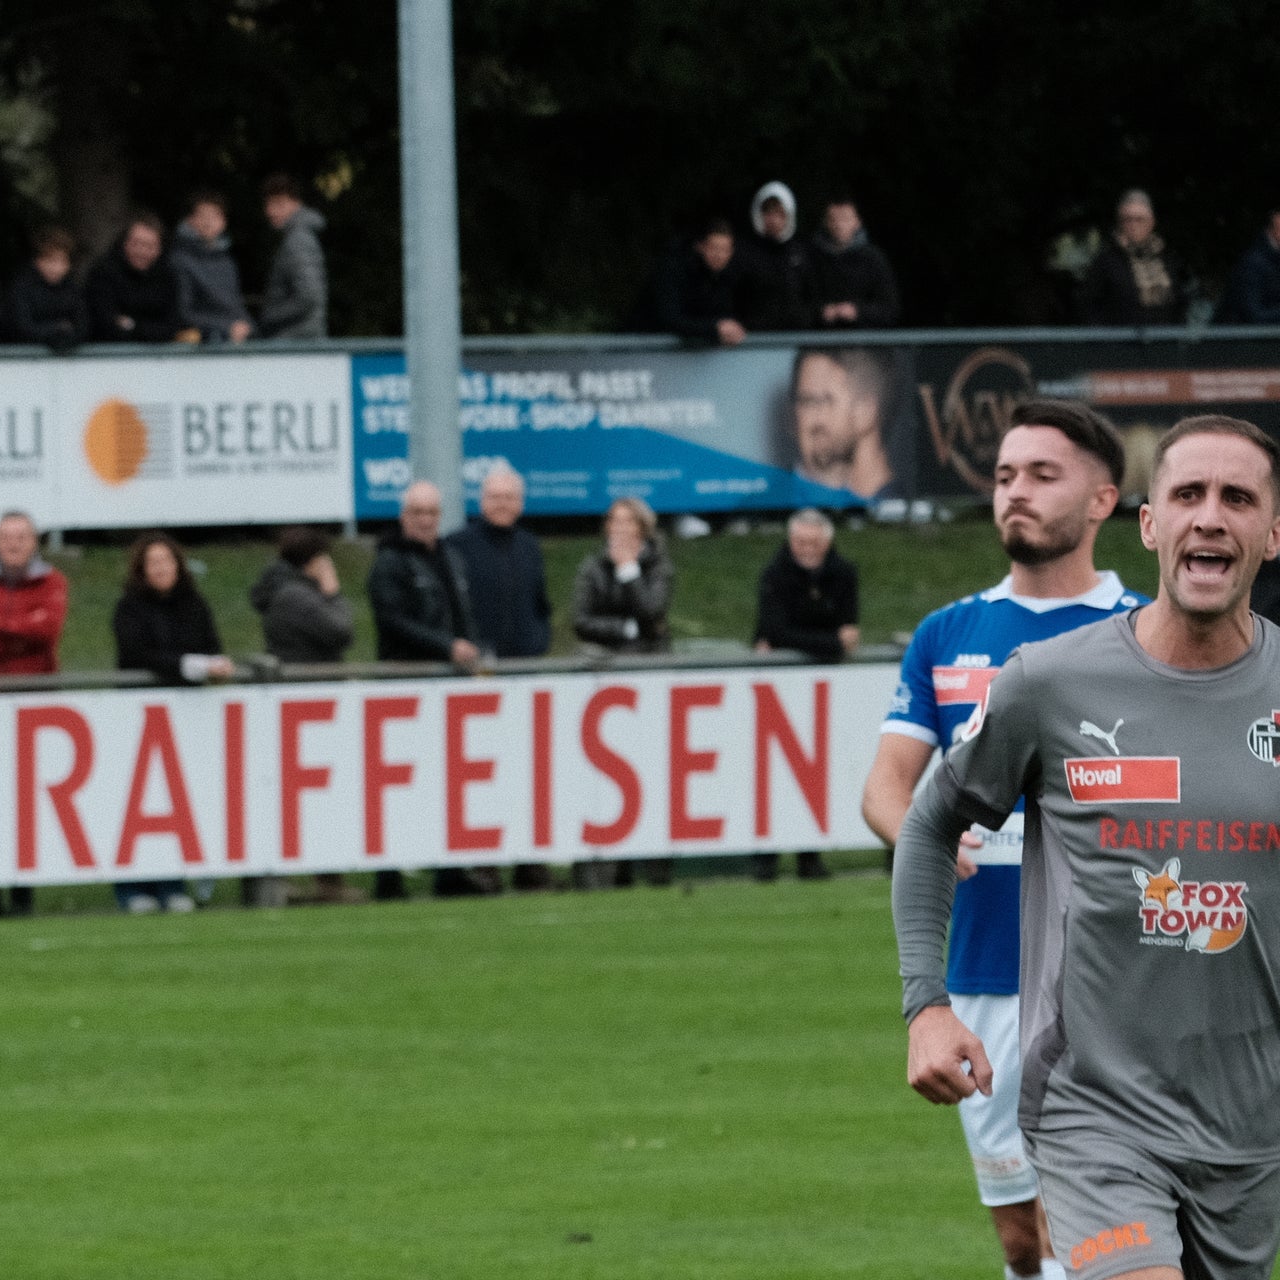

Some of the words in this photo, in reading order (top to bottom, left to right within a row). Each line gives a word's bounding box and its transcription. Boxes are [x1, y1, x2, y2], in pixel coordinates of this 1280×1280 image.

[182, 402, 339, 456] BEERLI
[15, 680, 830, 871] RAIFFEISEN
[1069, 764, 1122, 786] Hoval
[1099, 817, 1280, 852] RAIFFEISEN
[1180, 881, 1248, 909] FOX
[1142, 908, 1246, 936] TOWN
[1140, 936, 1184, 948] MENDRISIO
